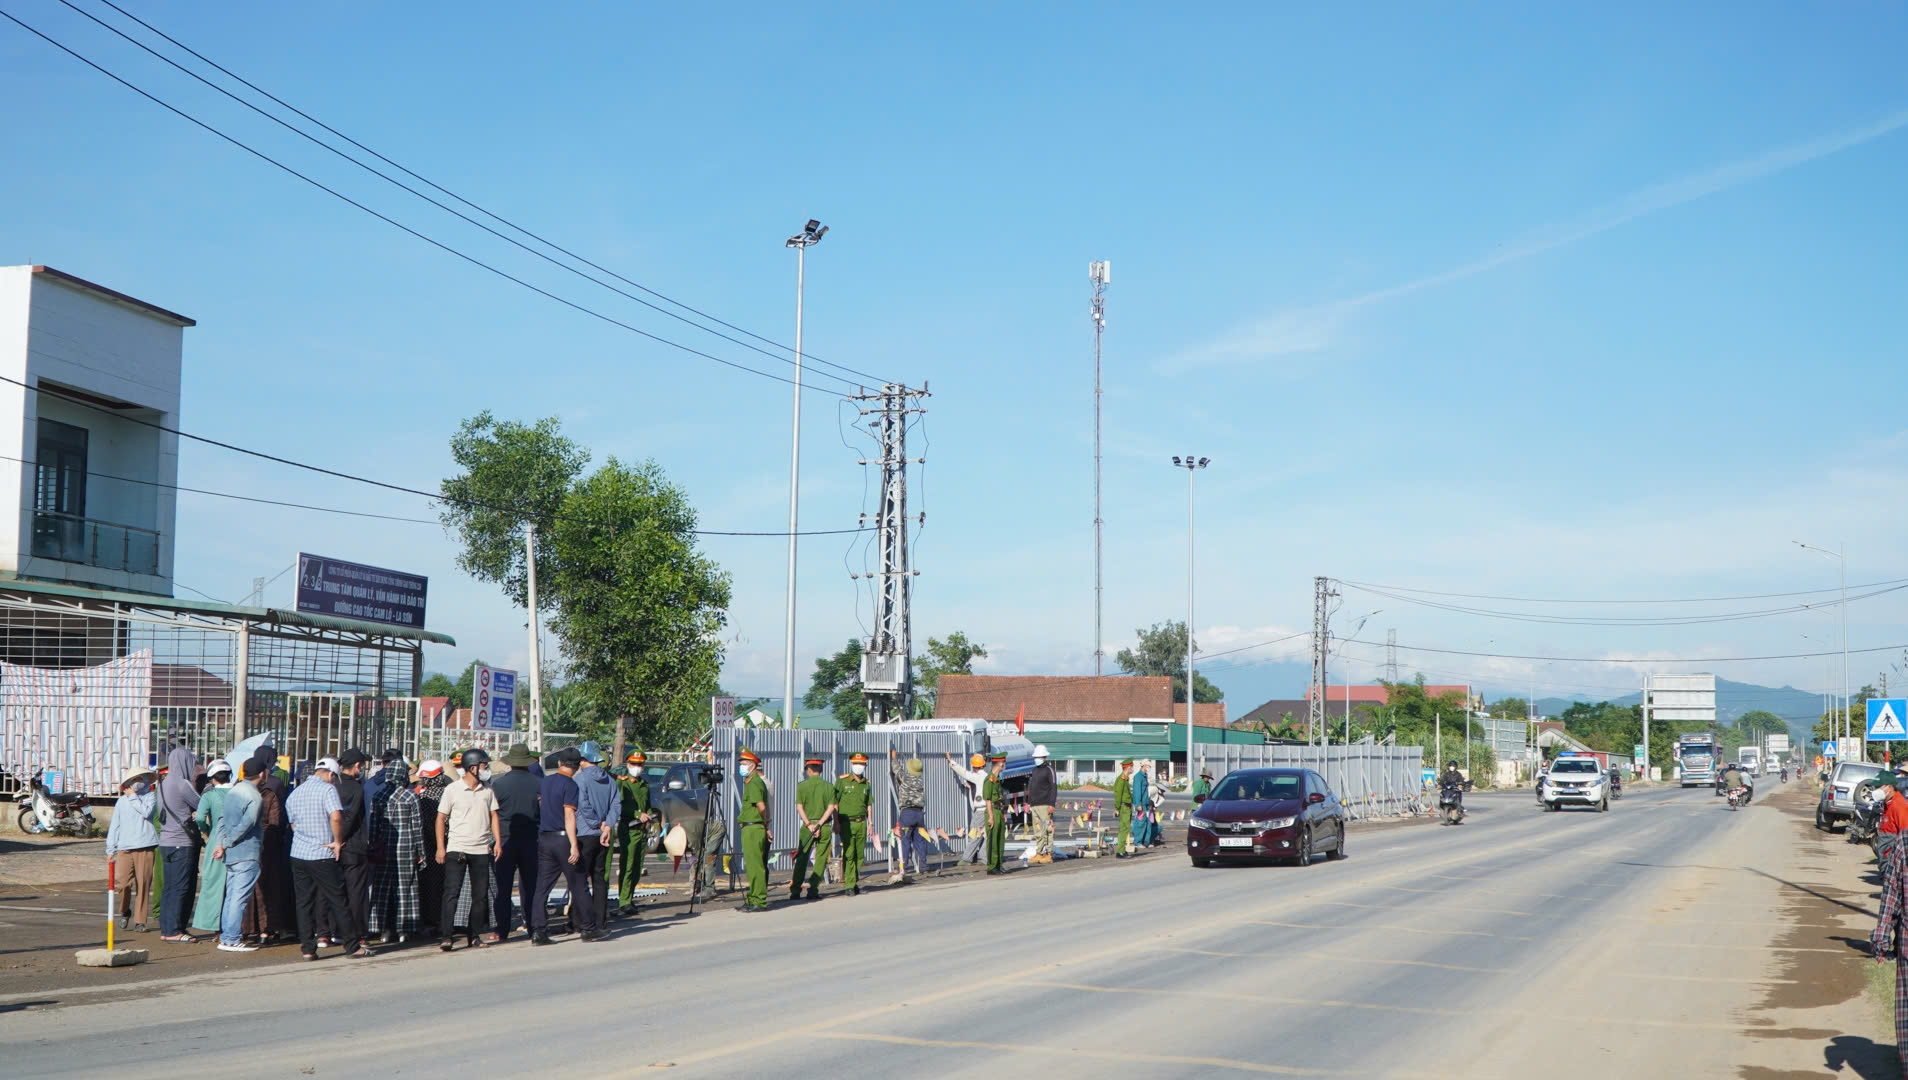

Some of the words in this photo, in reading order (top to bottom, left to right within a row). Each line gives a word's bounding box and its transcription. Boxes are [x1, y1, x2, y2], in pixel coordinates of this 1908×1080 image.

[323, 581, 340, 594] TRUNG
[341, 583, 352, 596] TÂM
[353, 584, 366, 598] QUẢN
[407, 592, 416, 606] BẢO
[353, 604, 363, 616] CAO
[364, 602, 373, 617] TỐC
[374, 607, 385, 619] CAM
[386, 607, 392, 623] LỘ
[396, 611, 402, 622] LA
